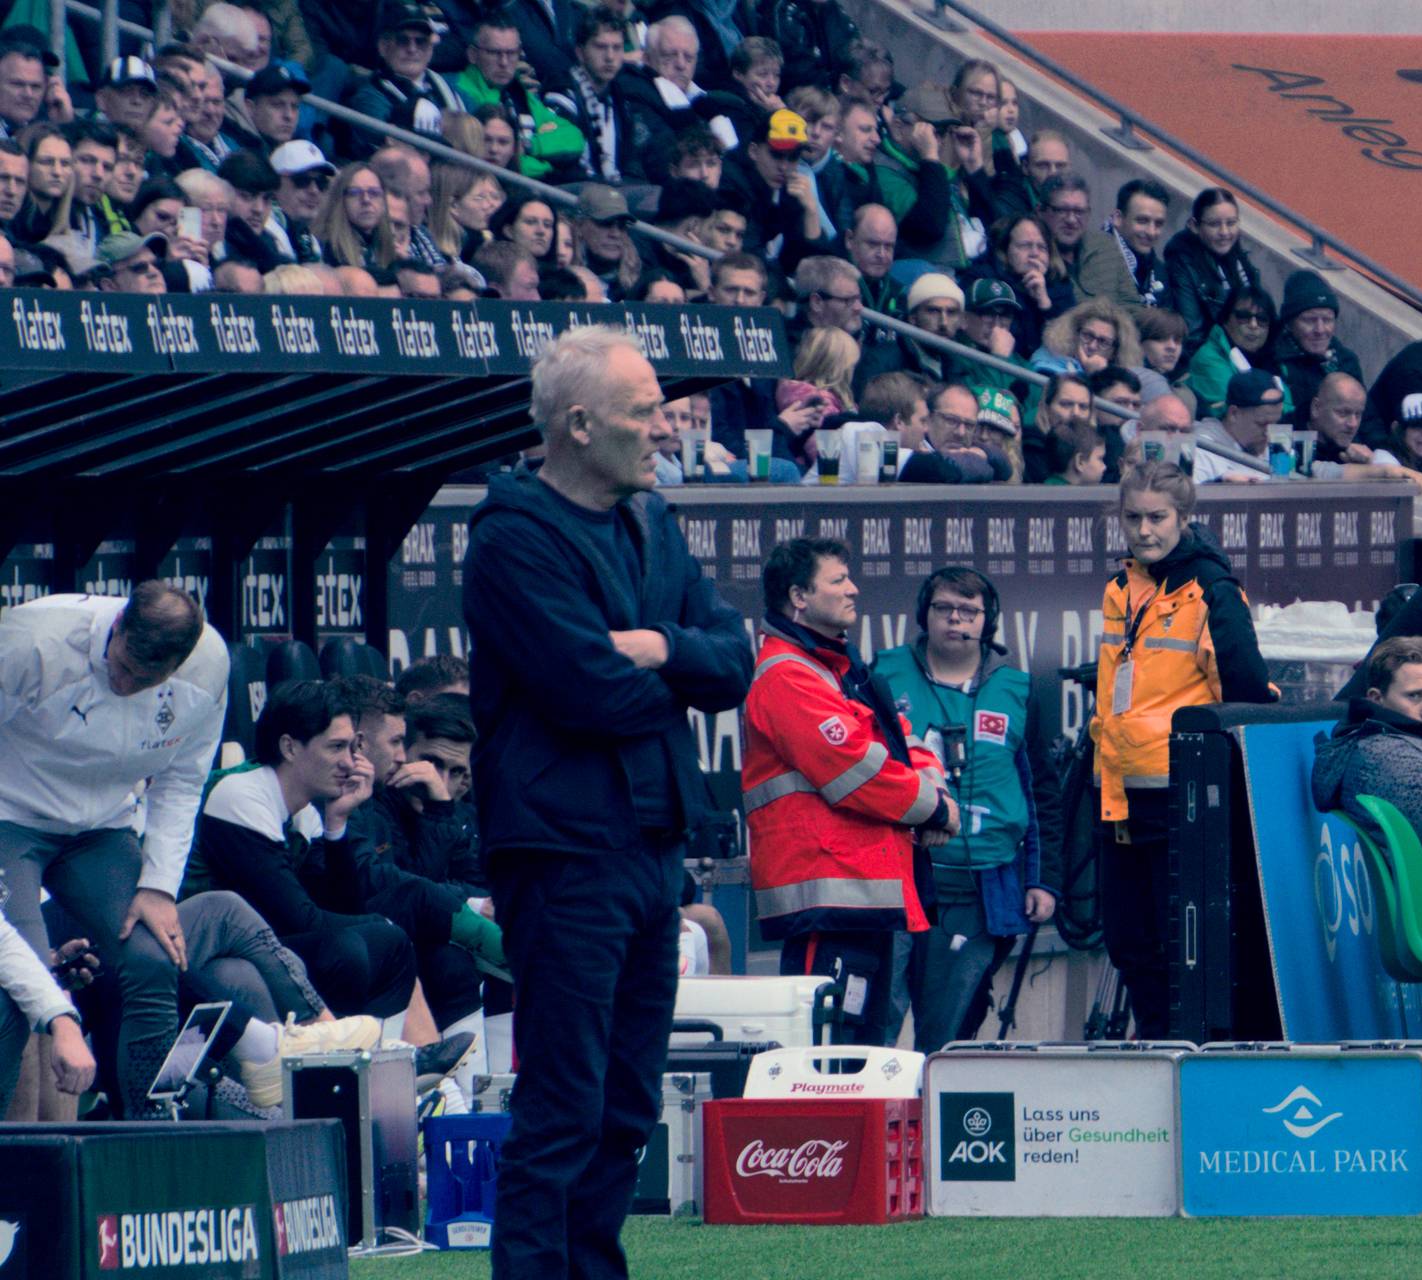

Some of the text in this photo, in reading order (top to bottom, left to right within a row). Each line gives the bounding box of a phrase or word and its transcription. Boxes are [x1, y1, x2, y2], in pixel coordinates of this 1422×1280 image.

[403, 524, 435, 563] BRAX
[688, 520, 717, 557] BRAX
[732, 519, 761, 556] BRAX
[863, 518, 891, 554] BRAX
[905, 517, 932, 553] BRAX
[946, 517, 974, 553] BRAX
[988, 517, 1015, 552] BRAX
[1029, 517, 1054, 552] BRAX
[1068, 517, 1093, 552] BRAX
[1223, 514, 1247, 547] BRAX
[1260, 514, 1284, 547] BRAX
[1297, 513, 1321, 547] BRAX
[1334, 512, 1358, 545] BRAX
[1371, 511, 1395, 544] BRAX
[790, 1083, 865, 1095] Playmate
[1023, 1107, 1100, 1122] Lass uns
[948, 1141, 1007, 1164] AOK
[1023, 1127, 1170, 1144] über Gesundheit
[735, 1139, 850, 1178] Coca-Cola
[1023, 1149, 1080, 1164] reden!
[1199, 1149, 1409, 1174] MEDICAL PARK
[121, 1207, 258, 1269] BUNDESLIGA
[283, 1194, 341, 1254] BUNDESLIGA
